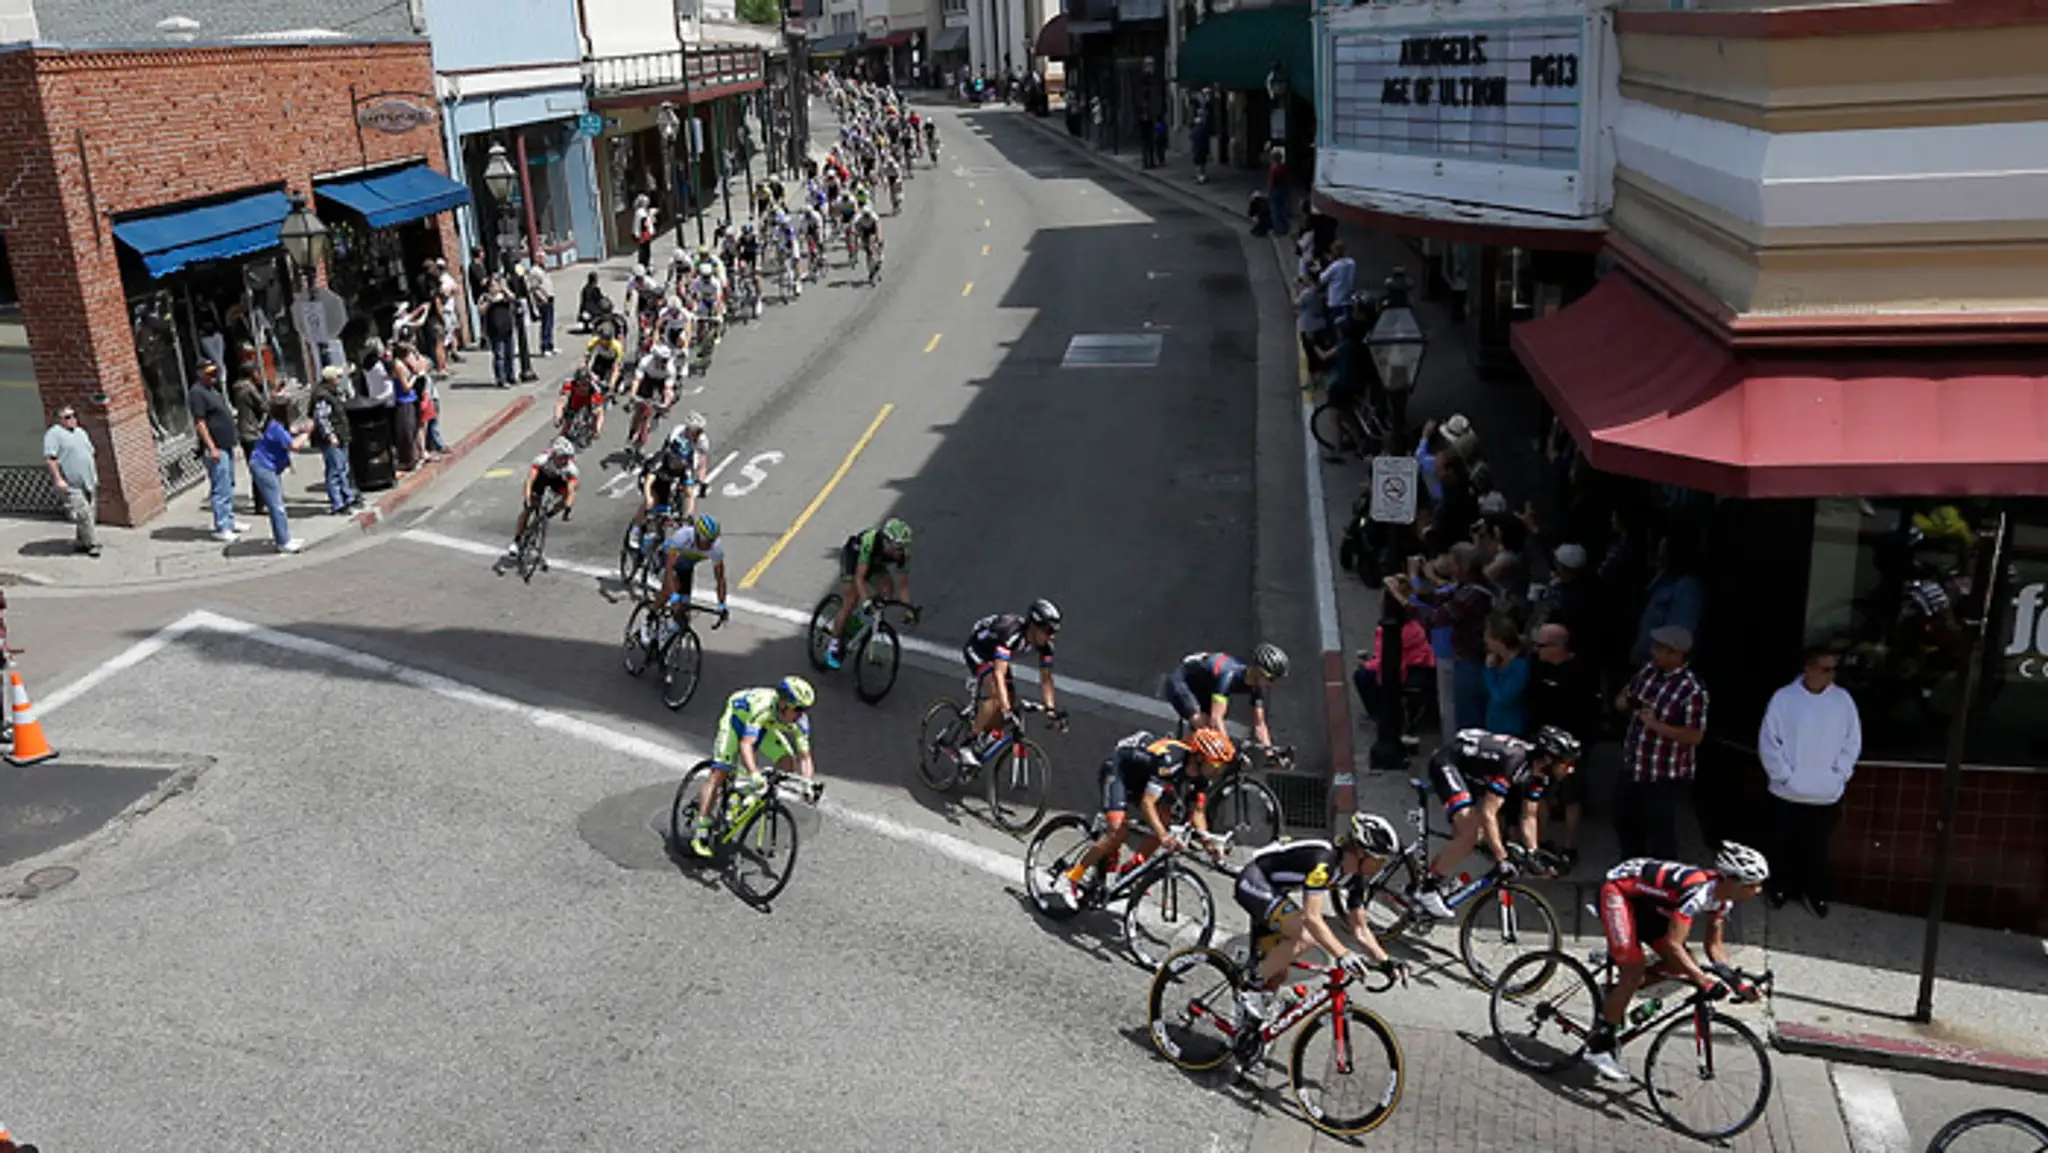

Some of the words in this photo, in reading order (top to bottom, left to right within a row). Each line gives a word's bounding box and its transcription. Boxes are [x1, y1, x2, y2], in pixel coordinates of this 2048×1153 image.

[1382, 76, 1411, 106] AGE
[1414, 76, 1434, 106] OF
[1439, 76, 1508, 107] ULTRON
